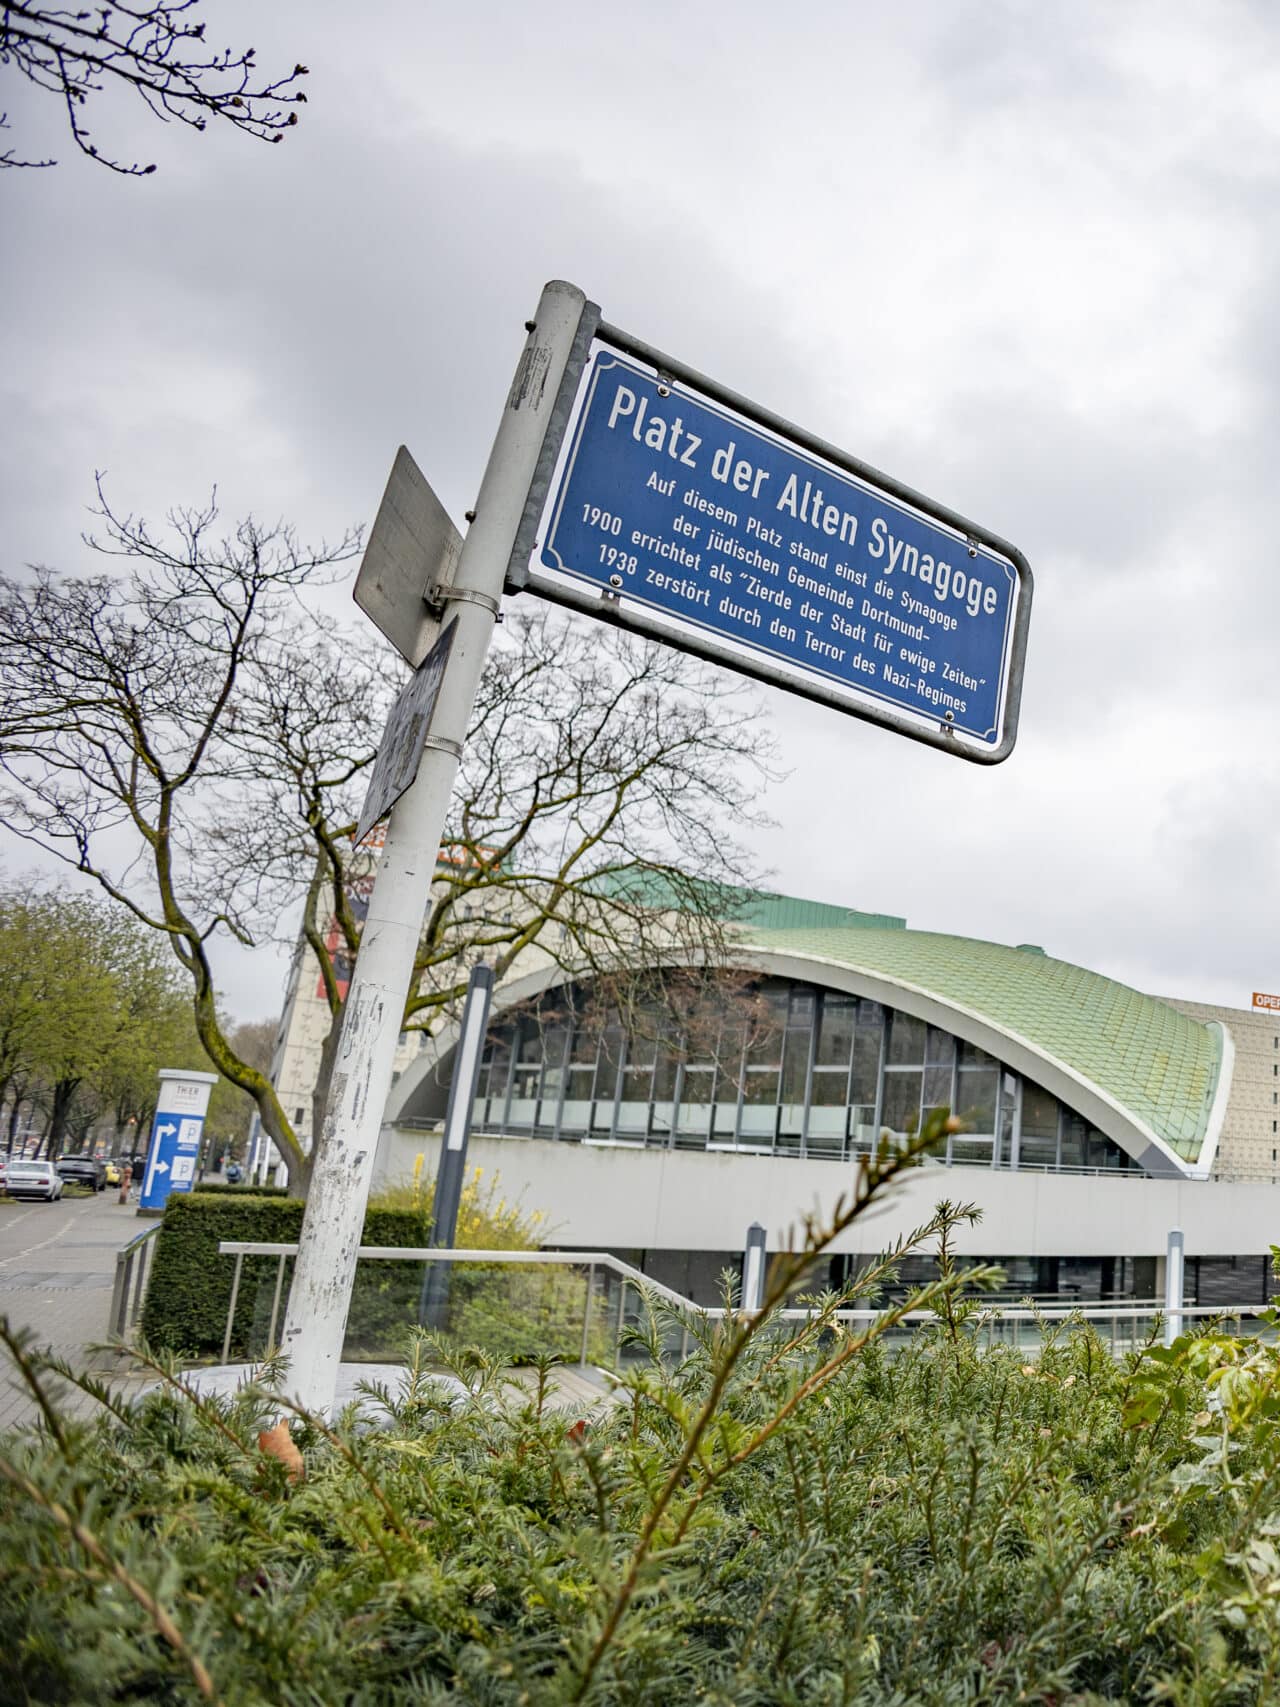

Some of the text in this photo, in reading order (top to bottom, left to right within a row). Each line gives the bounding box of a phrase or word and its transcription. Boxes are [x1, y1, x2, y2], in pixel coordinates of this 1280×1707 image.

[608, 385, 997, 617] Platz der Alten Synagoge
[646, 471, 957, 631] Auf diesem Platz stand einst die Synagoge
[673, 515, 930, 642] der jüdischen Gemeinde Dortmund-
[583, 504, 986, 691] 1900 errichtet als "Zierde der Stadt für ewige Zeiten"
[600, 544, 967, 712] 1938 zerstört durch den Terror des Nazi-Regimes
